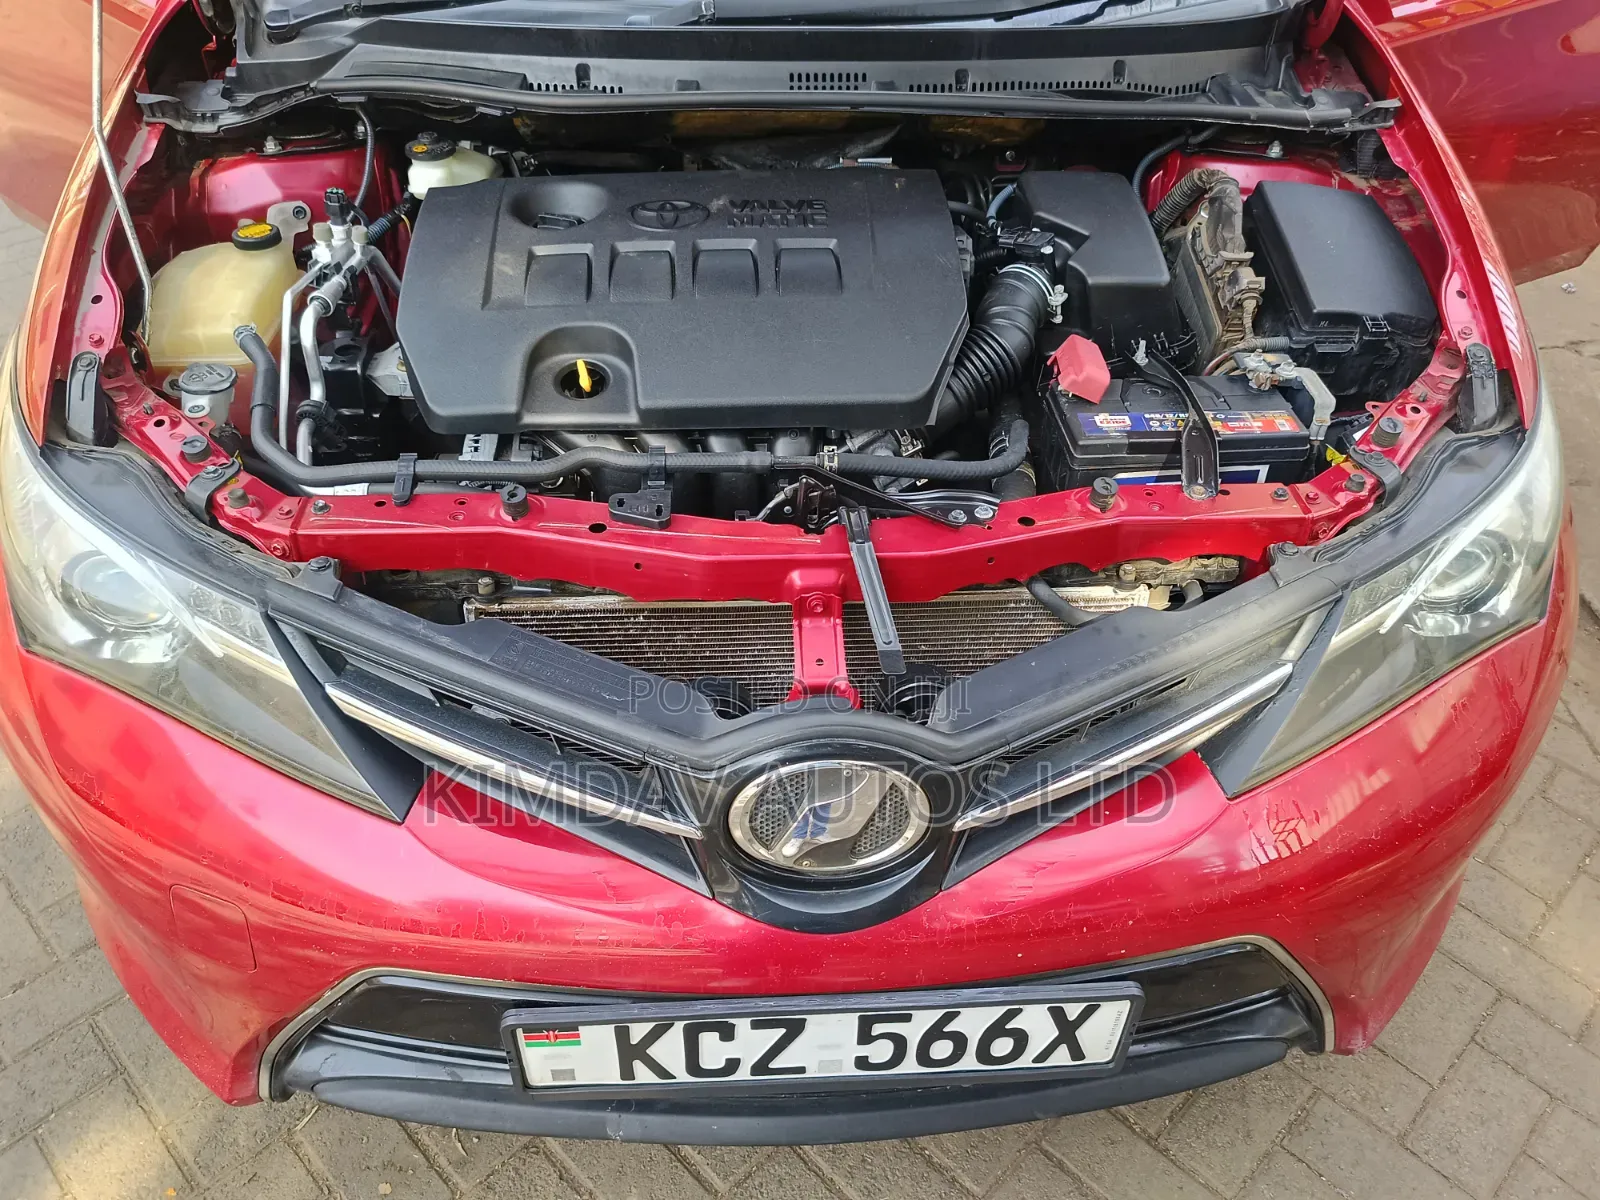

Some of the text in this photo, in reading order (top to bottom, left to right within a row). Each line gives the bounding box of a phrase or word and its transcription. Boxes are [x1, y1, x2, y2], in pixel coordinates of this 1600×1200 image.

[728, 199, 827, 213] VALVE
[614, 1017, 807, 1081] KCZ
[854, 1003, 1101, 1072] 566X
